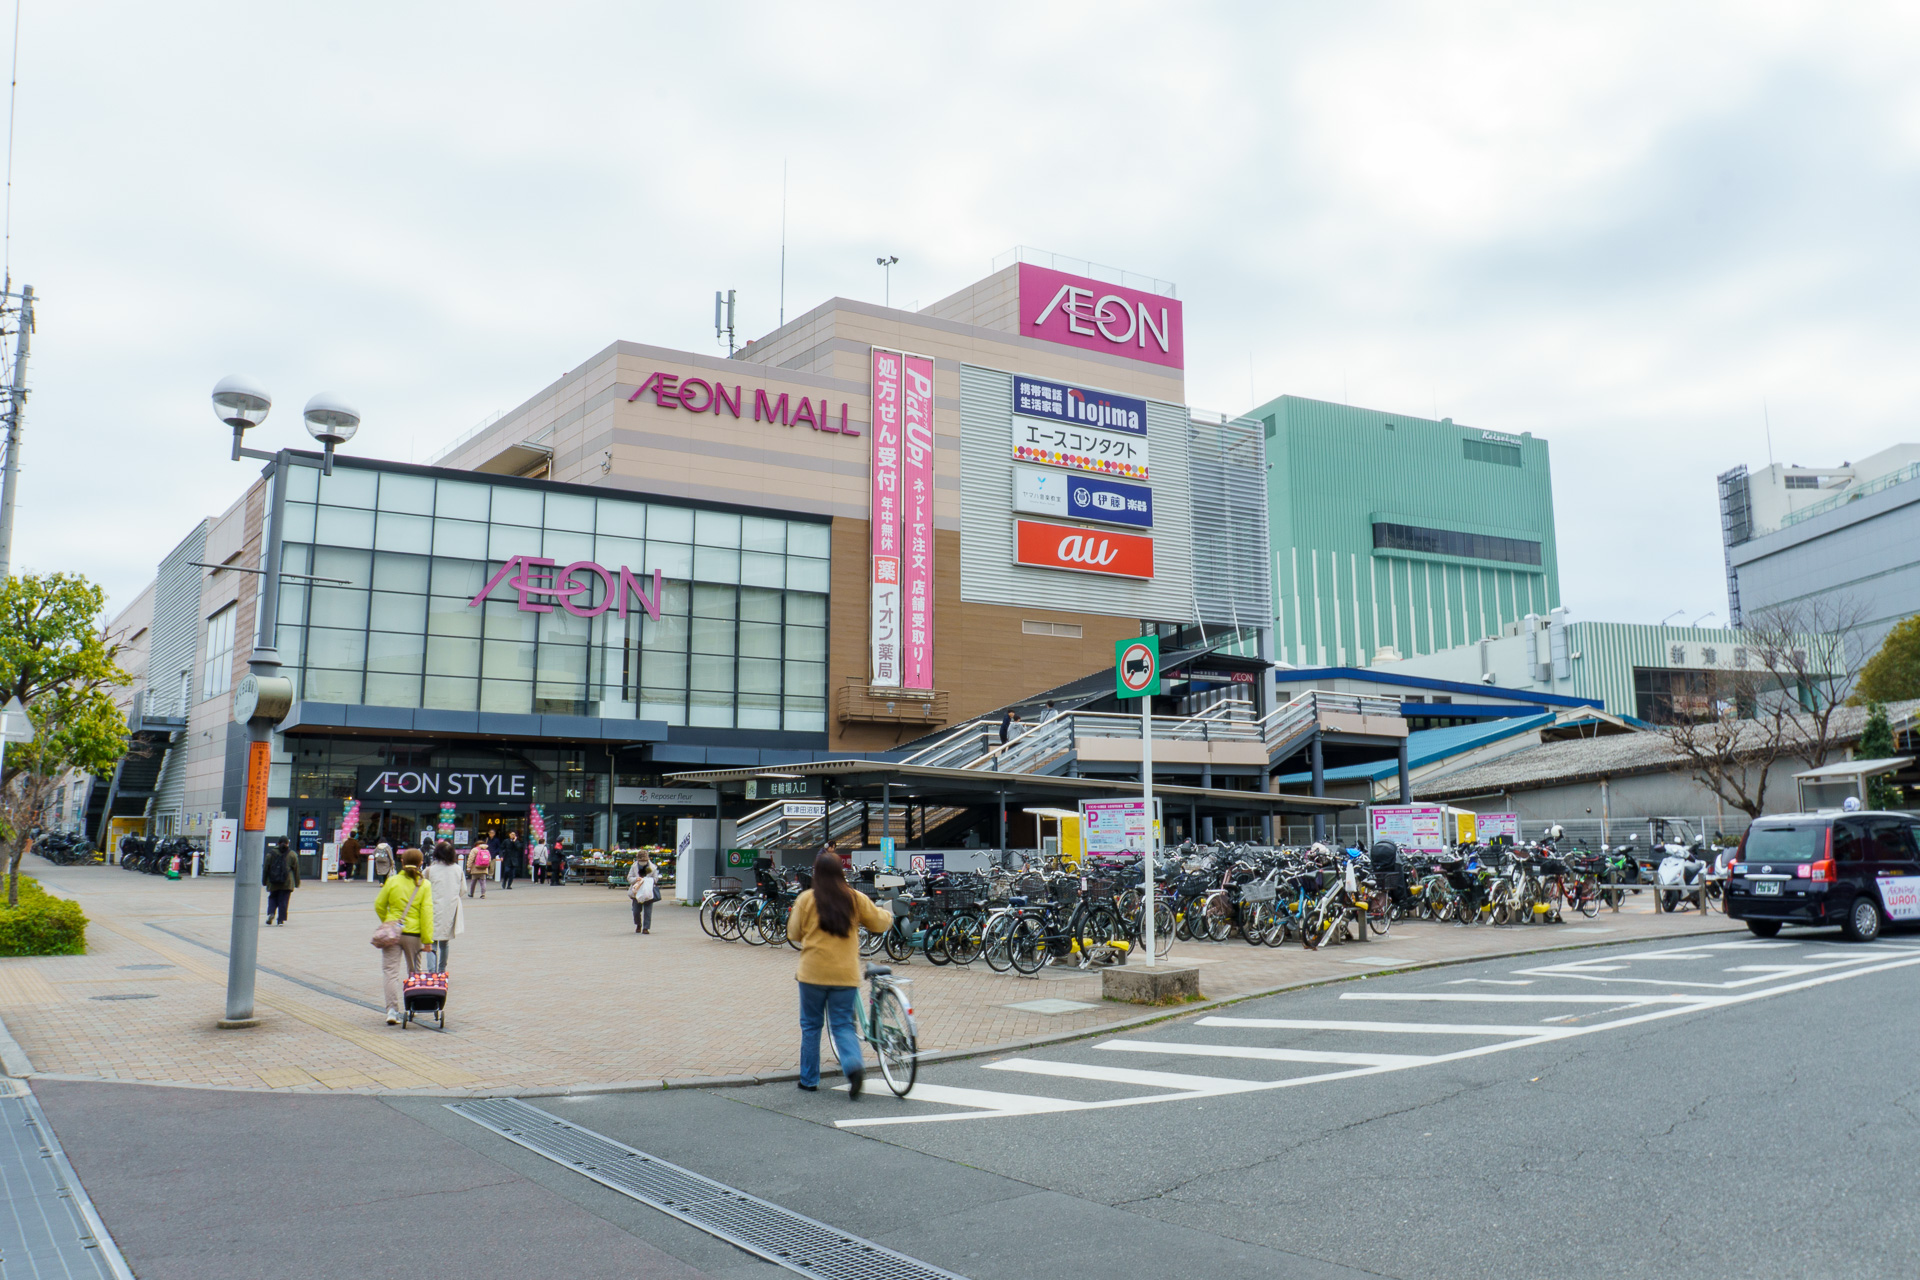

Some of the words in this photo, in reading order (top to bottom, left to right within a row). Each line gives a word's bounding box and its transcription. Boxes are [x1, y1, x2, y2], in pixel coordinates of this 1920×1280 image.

[1019, 382, 1063, 402] 携帯電話
[754, 388, 861, 437] MALL
[1020, 396, 1063, 416] 生活家電
[1067, 387, 1140, 430] nojima
[877, 356, 898, 492] 処方せん受付
[1026, 425, 1138, 459] エースコンタクト
[1022, 490, 1062, 503] ヤマハ音楽教室
[1097, 493, 1121, 509] 伊藤
[1126, 498, 1148, 513] 楽器
[880, 496, 894, 551] 年中無休
[1057, 534, 1118, 566] au
[877, 559, 896, 581] 薬
[911, 478, 927, 678] ネットで注文、店舗受取り！
[877, 591, 894, 679] イオン薬局
[447, 773, 526, 796] STYLE
[770, 781, 807, 796] 駐輪場入口
[650, 792, 677, 801] Reposer
[677, 792, 693, 801] fleur
[786, 805, 820, 815] 新津田沼駅
[1087, 811, 1099, 829] P
[1375, 815, 1386, 830] P
[1479, 819, 1486, 830] P
[1888, 894, 1918, 906] WAON
